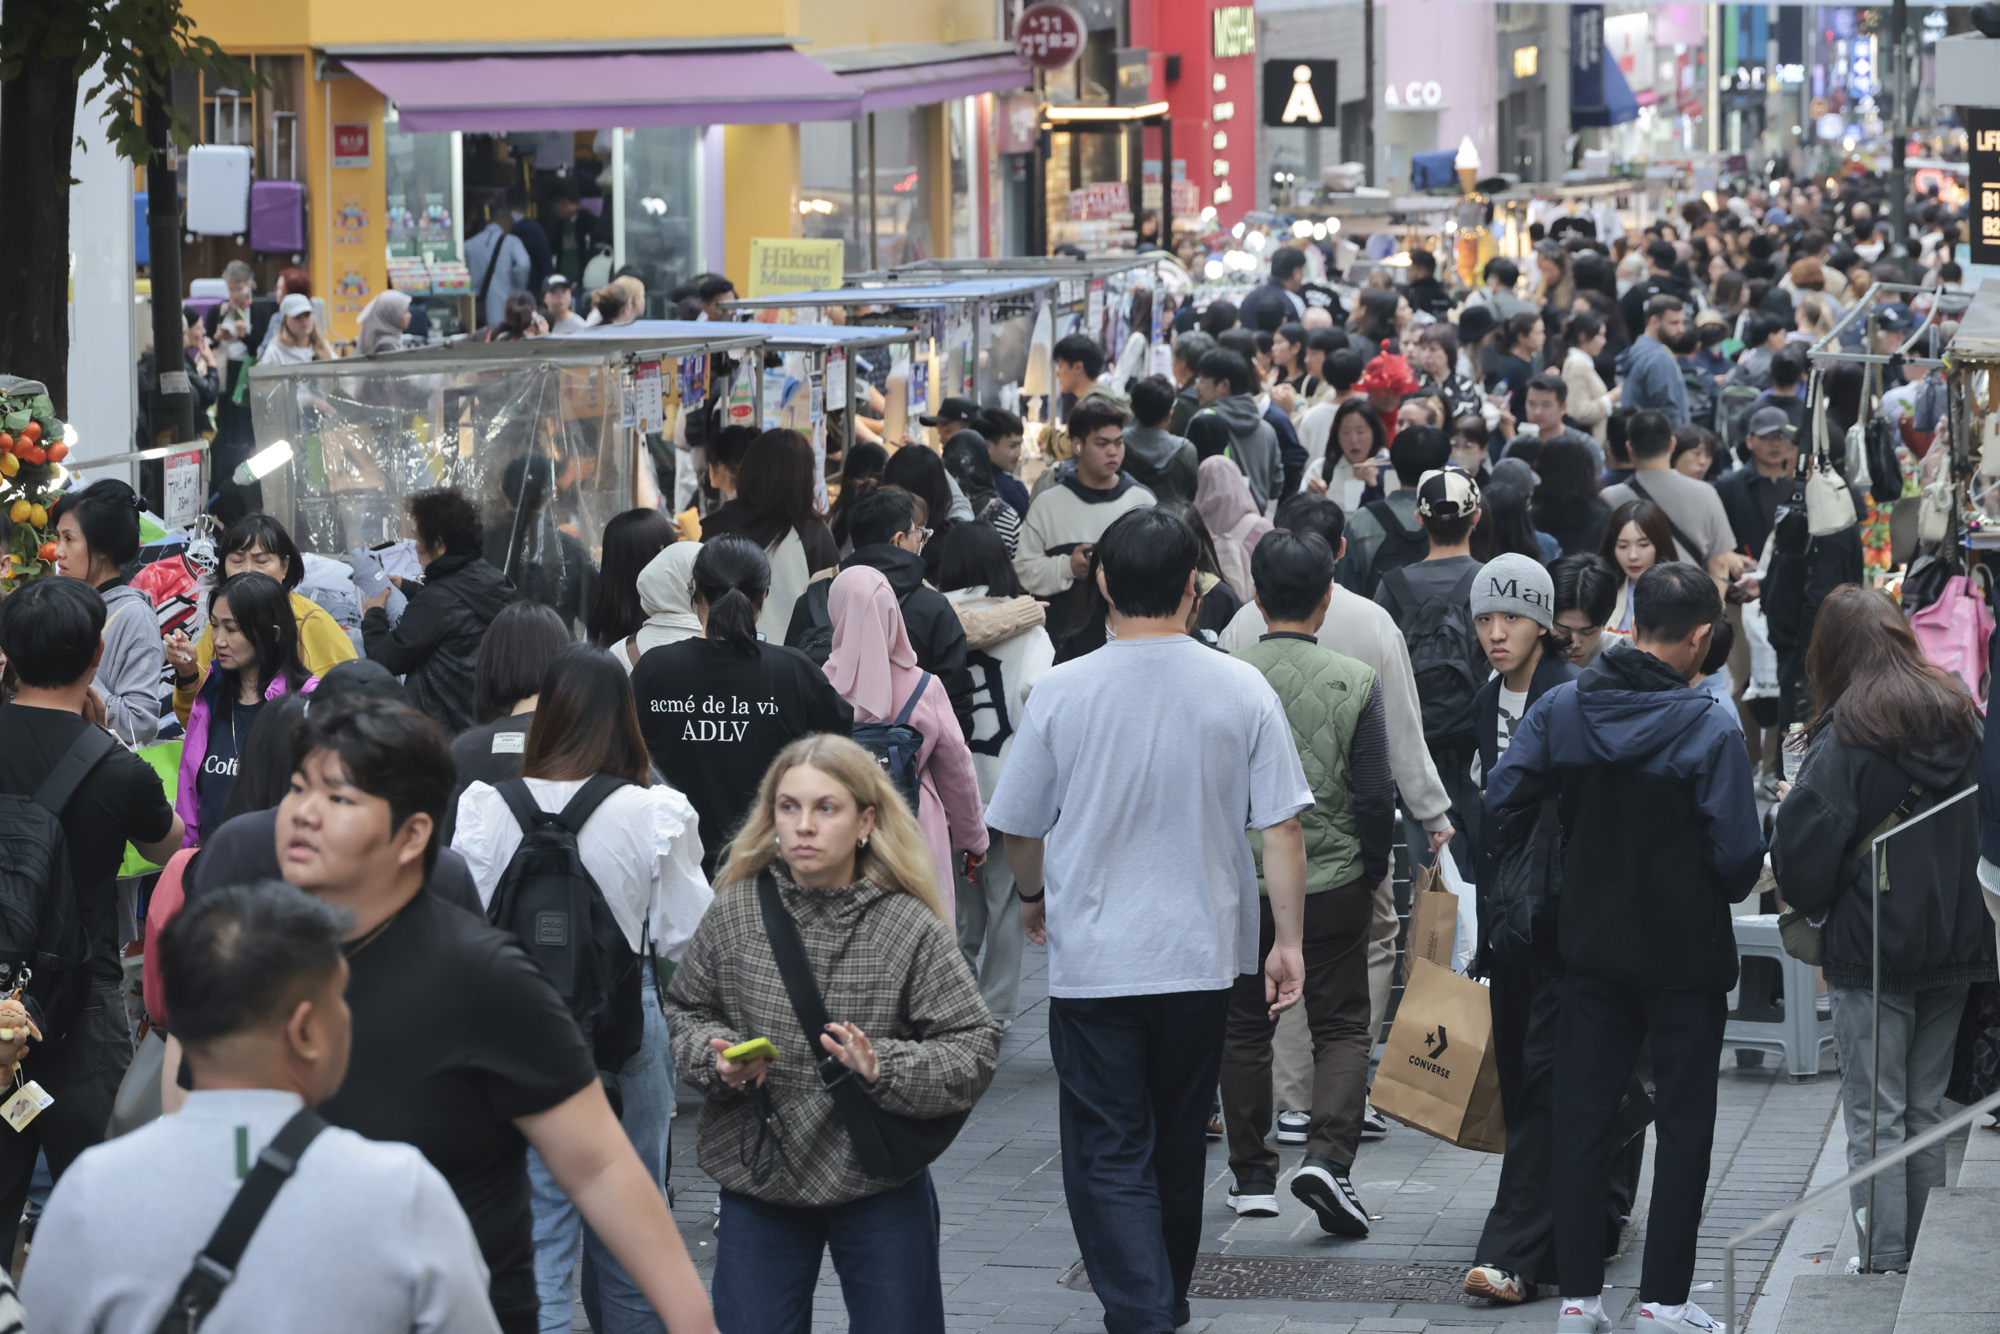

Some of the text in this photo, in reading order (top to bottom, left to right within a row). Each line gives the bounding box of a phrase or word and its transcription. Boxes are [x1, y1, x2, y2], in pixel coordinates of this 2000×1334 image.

[1982, 190, 2000, 211] B1
[1982, 216, 2000, 237] B2
[760, 245, 831, 271] Hikari
[760, 267, 831, 291] Massage
[1488, 577, 1553, 612] Mat
[650, 694, 779, 715] acmé de la vi
[682, 719, 750, 742] ADLV
[1408, 1055, 1451, 1079] CONVERSE
